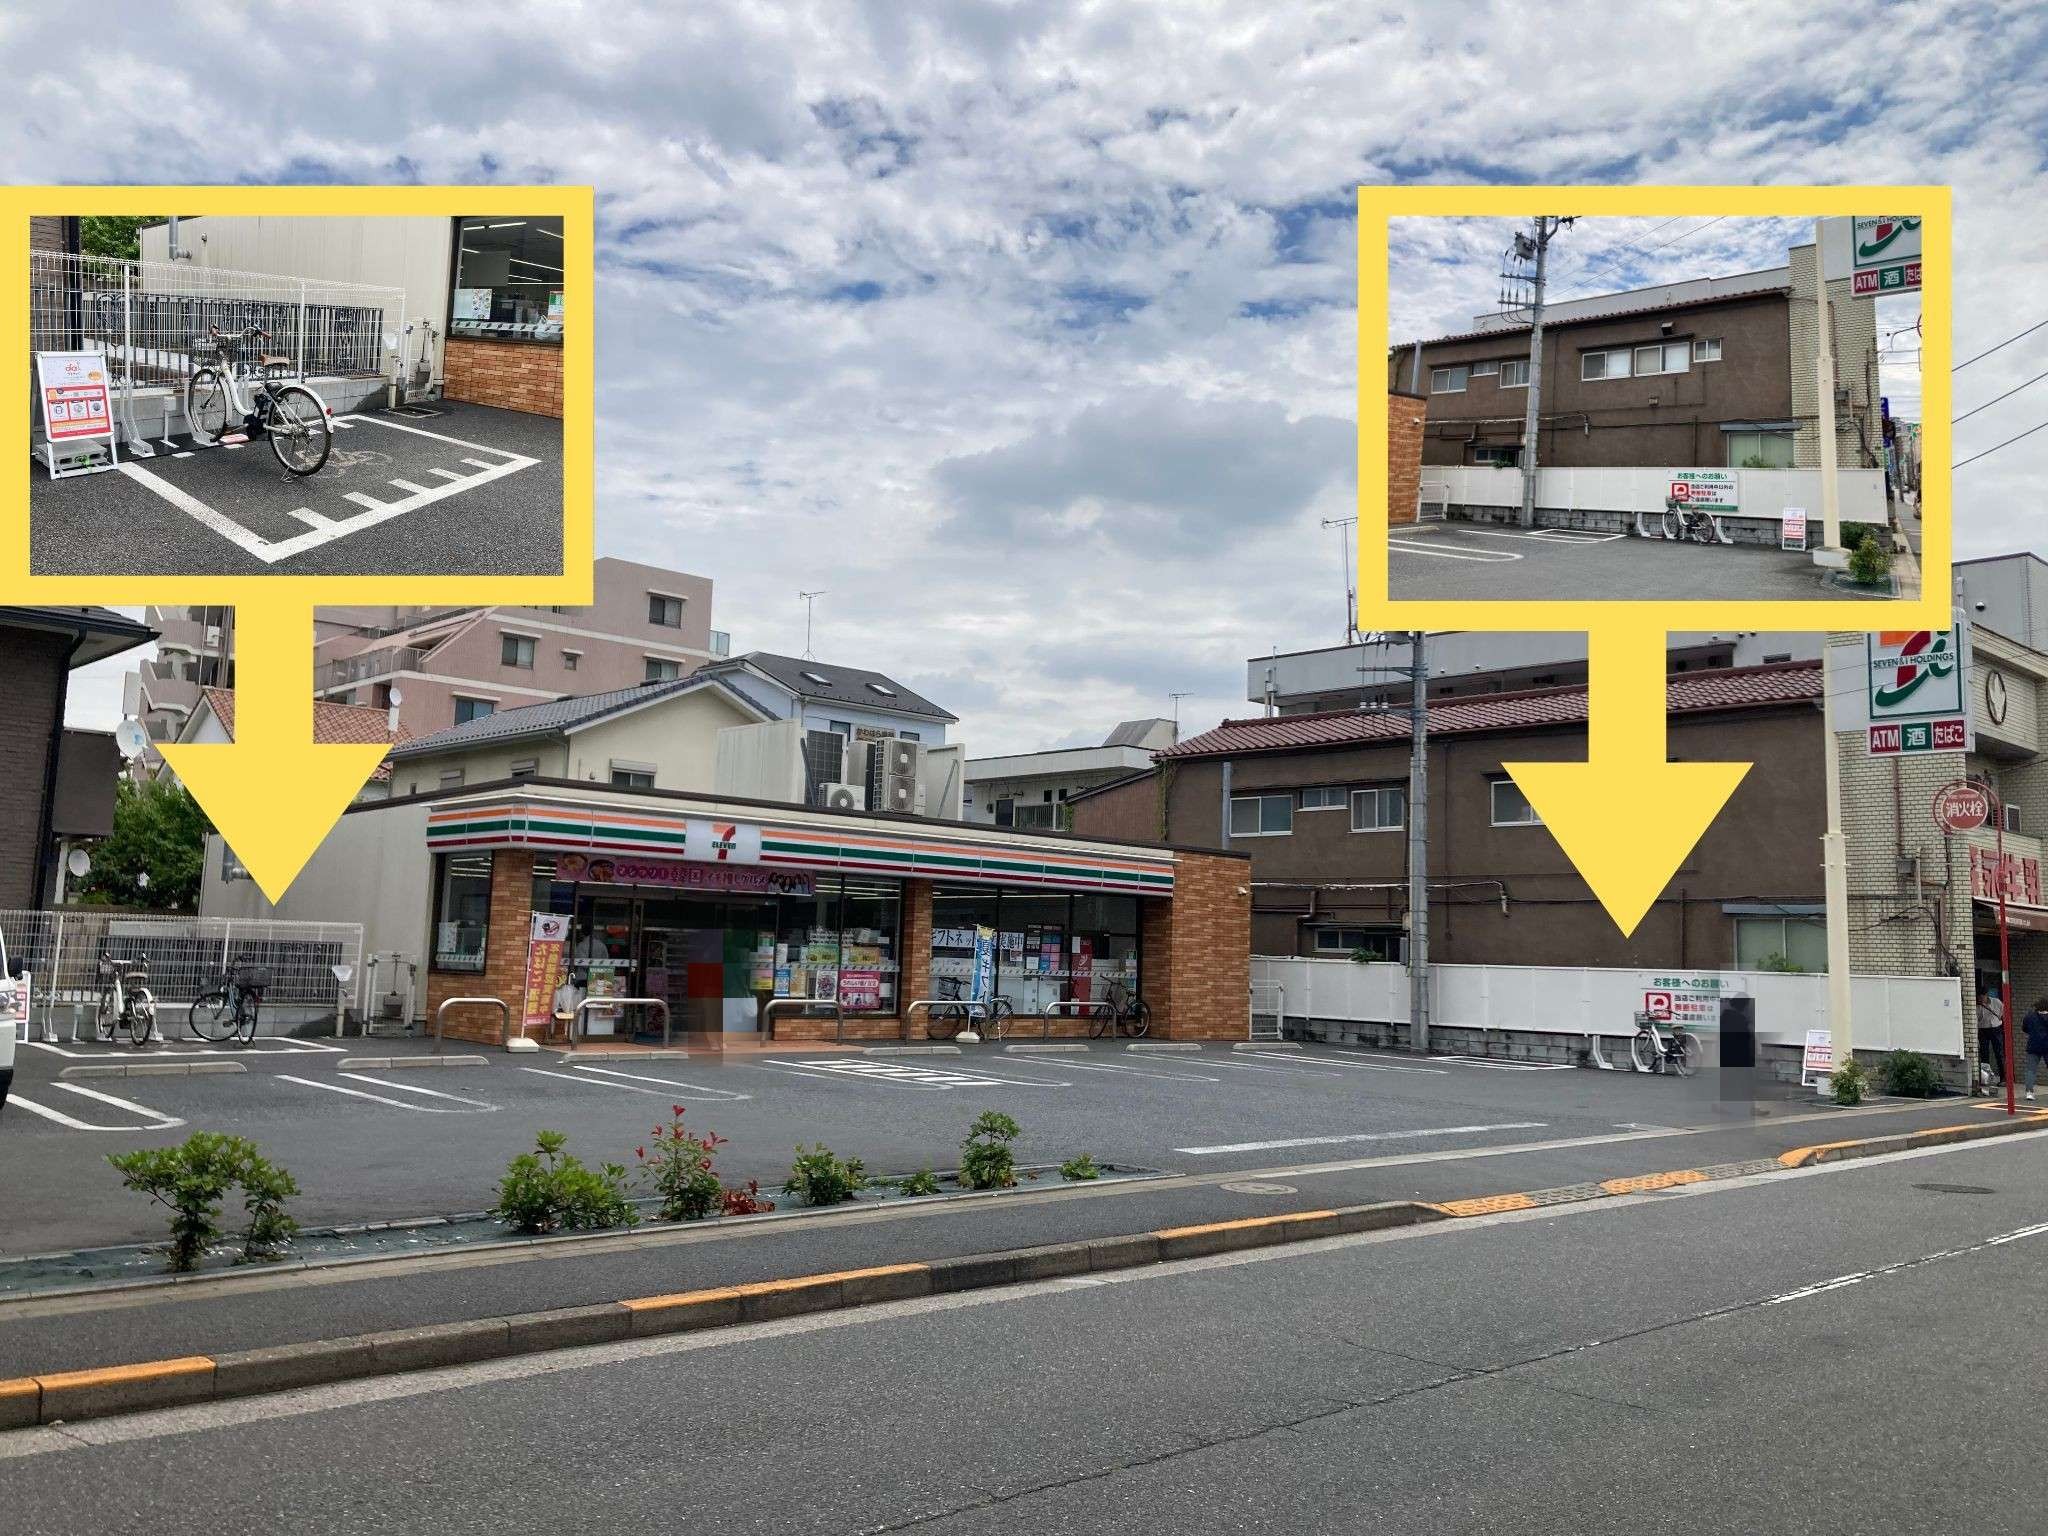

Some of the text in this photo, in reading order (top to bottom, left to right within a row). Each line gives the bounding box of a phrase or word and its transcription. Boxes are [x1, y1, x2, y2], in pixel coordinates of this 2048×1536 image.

[1855, 273, 1878, 289] ATM
[1884, 270, 1900, 287] 酒
[1910, 651, 1954, 664] HOLDINGS
[1872, 729, 1899, 748] ATM
[1906, 727, 1926, 747] 酒
[1934, 723, 1964, 744] たばこ
[1945, 801, 1984, 818] 消火栓
